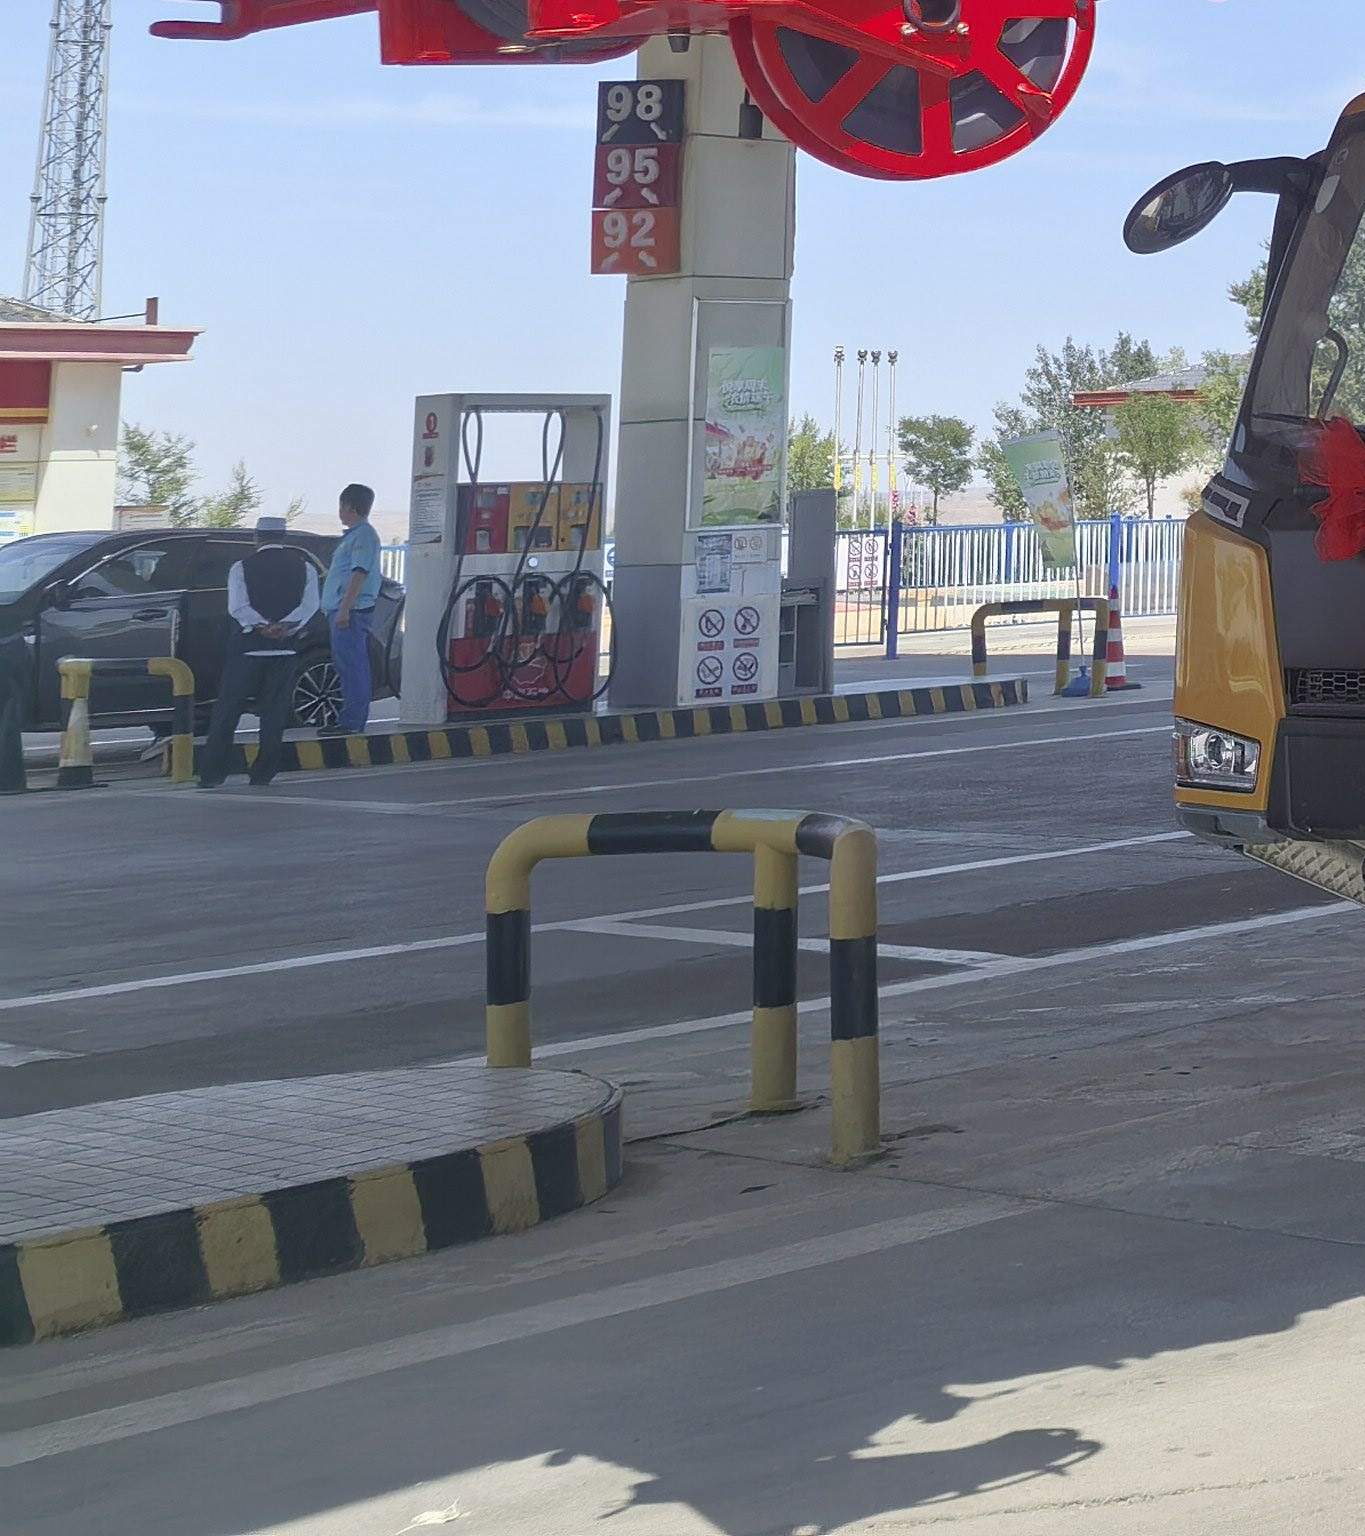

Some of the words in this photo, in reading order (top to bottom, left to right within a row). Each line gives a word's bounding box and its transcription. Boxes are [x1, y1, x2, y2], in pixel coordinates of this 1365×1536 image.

[606, 84, 663, 123] 98
[606, 147, 660, 185] 95
[603, 211, 656, 249] 92
